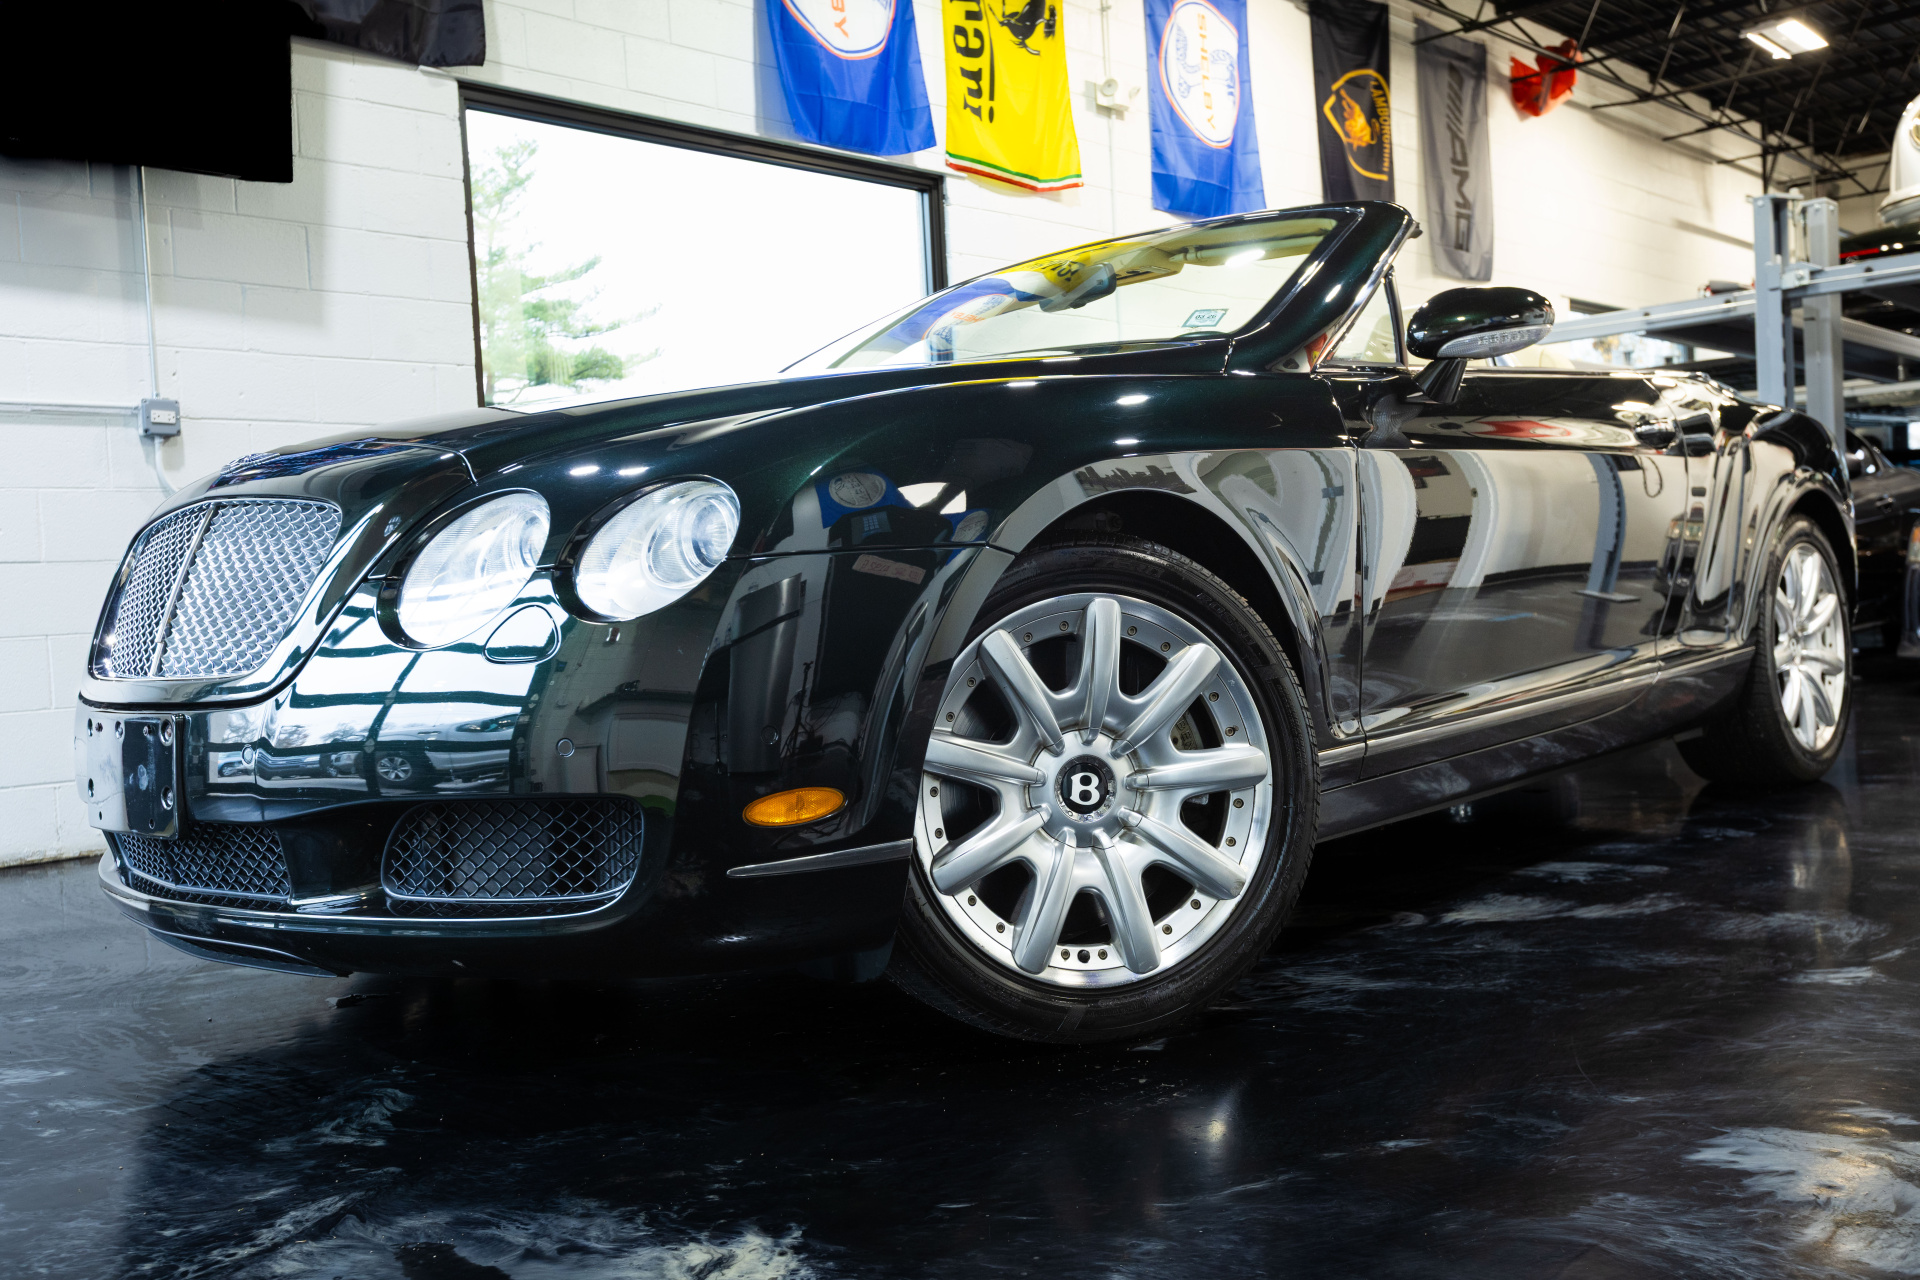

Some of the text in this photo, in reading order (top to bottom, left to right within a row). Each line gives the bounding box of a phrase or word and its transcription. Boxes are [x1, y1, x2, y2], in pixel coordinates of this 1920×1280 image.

[1198, 13, 1216, 130] SHELBY
[1369, 81, 1391, 171] LAMBORGHINI
[1070, 772, 1100, 805] B
